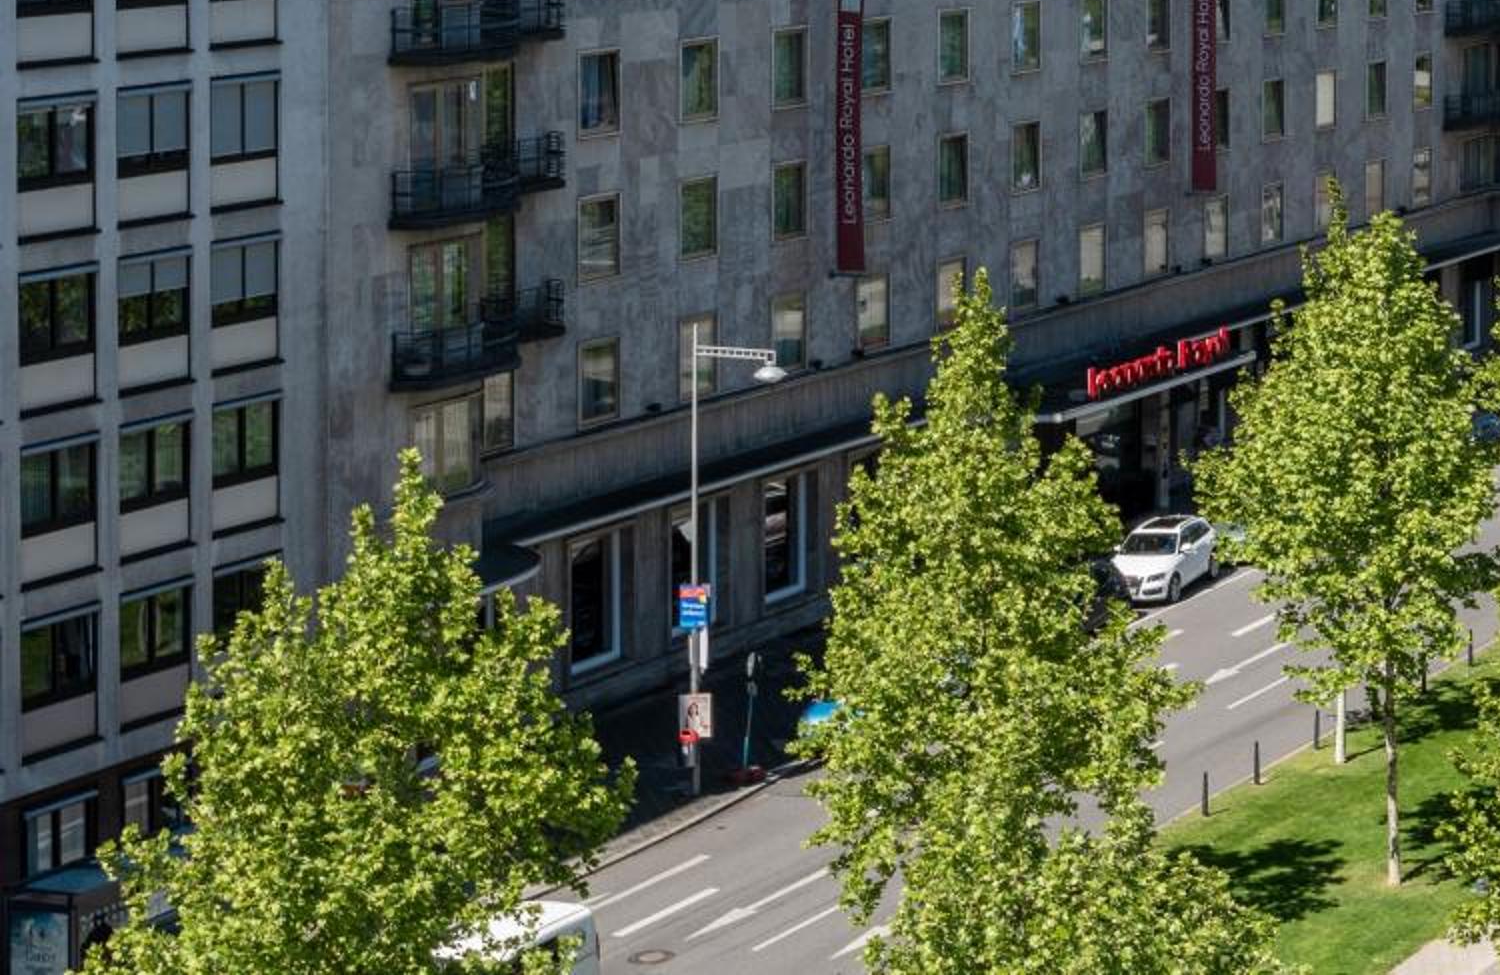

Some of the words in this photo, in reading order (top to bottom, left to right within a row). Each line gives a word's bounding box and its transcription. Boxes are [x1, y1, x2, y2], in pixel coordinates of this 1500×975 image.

[840, 24, 855, 72] Hotel
[1195, 28, 1211, 72] Royal
[840, 78, 856, 129] Royal
[1196, 75, 1211, 151] Leonardo
[841, 134, 857, 224] Leonardo
